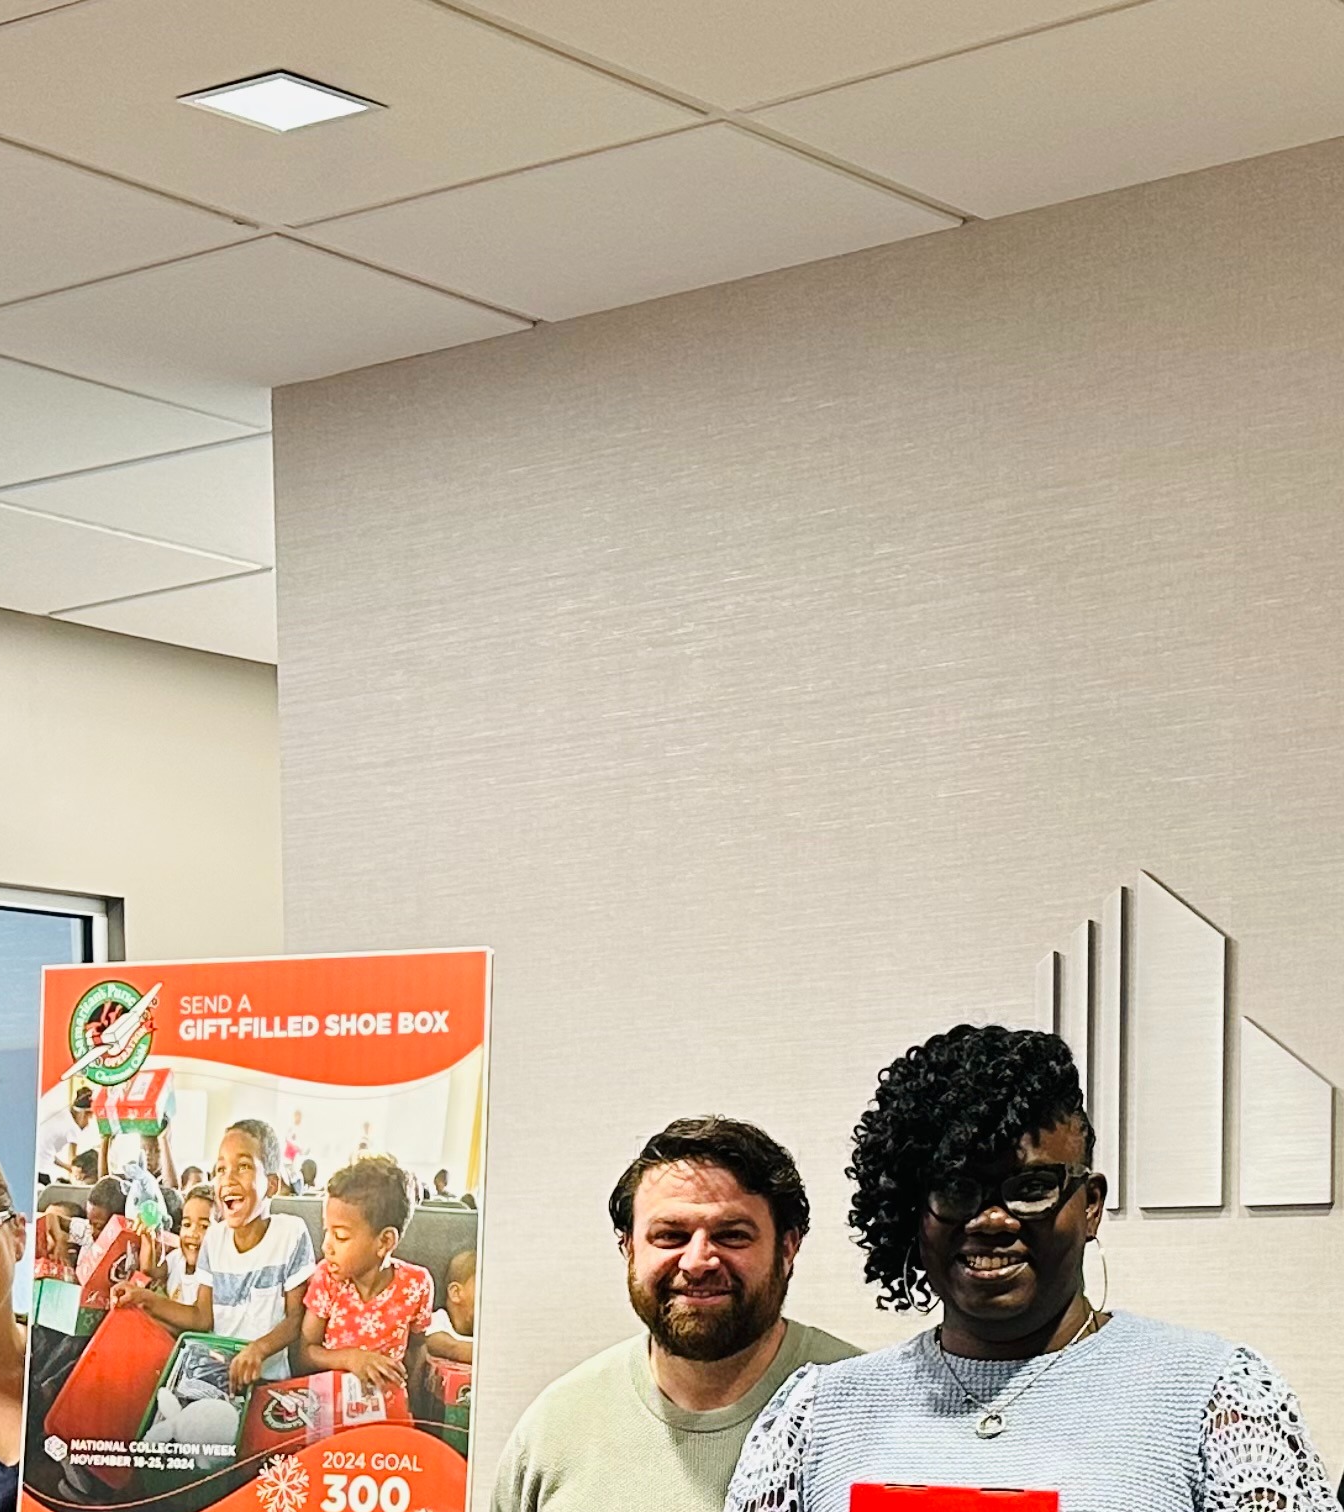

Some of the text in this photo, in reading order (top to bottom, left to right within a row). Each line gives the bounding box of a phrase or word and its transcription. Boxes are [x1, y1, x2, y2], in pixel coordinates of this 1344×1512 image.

[179, 994, 252, 1014] SEND A
[179, 1010, 450, 1041] GIFT-FILLED SHOE BOX
[70, 1438, 237, 1457] NATIONAL COLLECTION WEEK
[70, 1453, 131, 1467] NOVEMBER
[166, 1457, 195, 1471] 2024
[322, 1450, 423, 1472] 2024 GOAL
